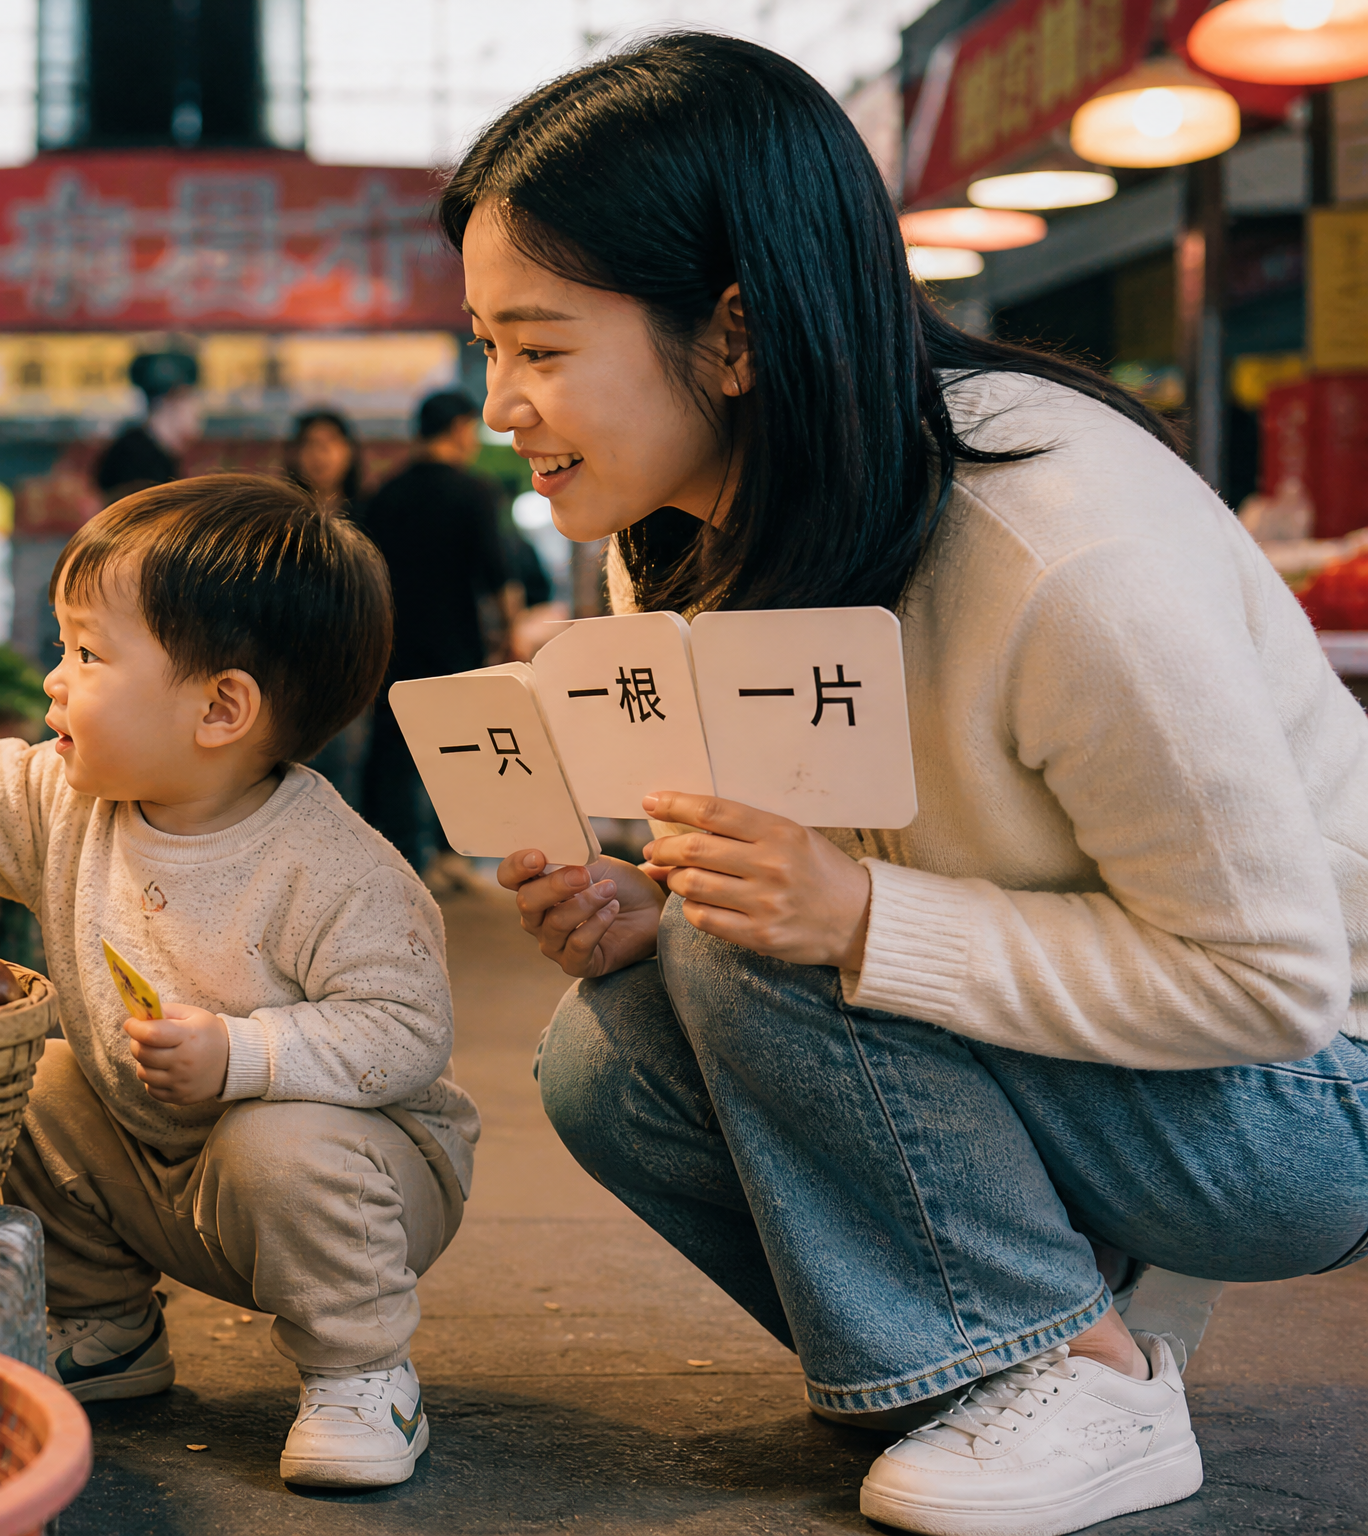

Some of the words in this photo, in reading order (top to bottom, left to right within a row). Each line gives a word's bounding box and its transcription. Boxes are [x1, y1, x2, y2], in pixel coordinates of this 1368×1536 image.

[567, 666, 667, 724] 一根
[738, 664, 862, 727] 一片
[438, 727, 533, 777] 一只
